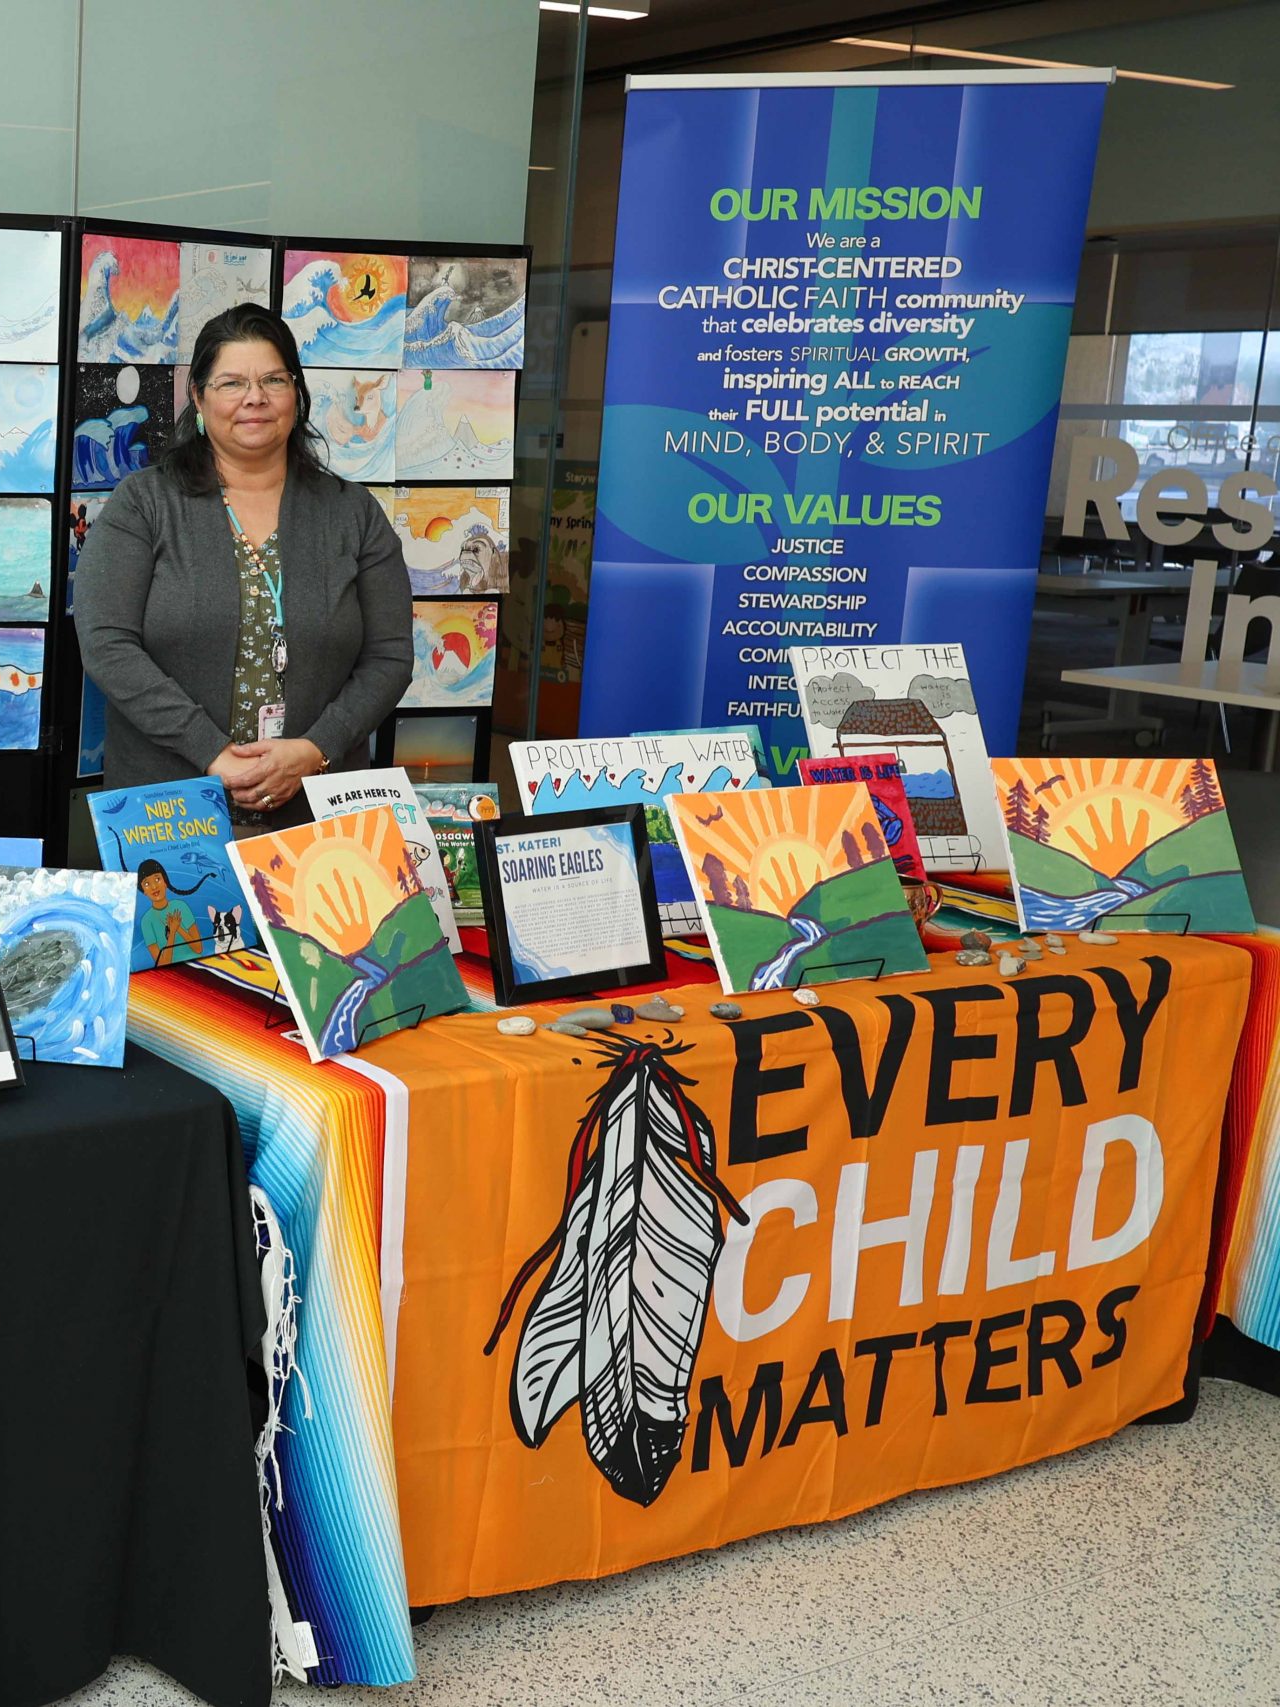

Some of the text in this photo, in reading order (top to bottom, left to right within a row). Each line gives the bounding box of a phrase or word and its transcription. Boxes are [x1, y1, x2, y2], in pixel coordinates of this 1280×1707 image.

[710, 186, 983, 221] OUR MISSION
[806, 232, 881, 249] We are a
[723, 256, 962, 279] CHRIST-CENTERED
[658, 285, 1025, 314] CATHOLIC FAITH community
[702, 311, 975, 339] that celebrates diversity
[697, 344, 971, 364] and fosters SPIRITUAL GROWTH,
[723, 367, 960, 395] inspiring ALL to REACH
[708, 399, 947, 427] their FULL potential in
[664, 431, 990, 458] MIND, BODY, & SPIRIT
[1061, 436, 1279, 551] Res
[687, 492, 942, 526] OUR VALUES
[771, 538, 844, 555] JUSTICE
[743, 565, 867, 583] COMPASSION
[738, 593, 867, 611] STEWARDSHIP
[722, 620, 878, 638] ACCOUNTABILITY
[801, 646, 964, 673] PROTECT THE
[812, 681, 852, 694] Protect
[728, 701, 803, 718] FAITHFU
[526, 738, 755, 770] PROTECT THE WATER
[810, 763, 901, 783] WATER IS LIFE
[327, 788, 401, 807] WE ARE HERE TO
[144, 798, 187, 821] NIBI'S
[123, 822, 176, 845] WATER
[496, 837, 561, 855] ST. KATERI
[502, 848, 604, 884] SOARING EAGLES
[532, 886, 552, 894] WATER
[726, 954, 1173, 1166] EVERY
[715, 1113, 1164, 1342] CHILD
[690, 1284, 1140, 1473] MATTERS
